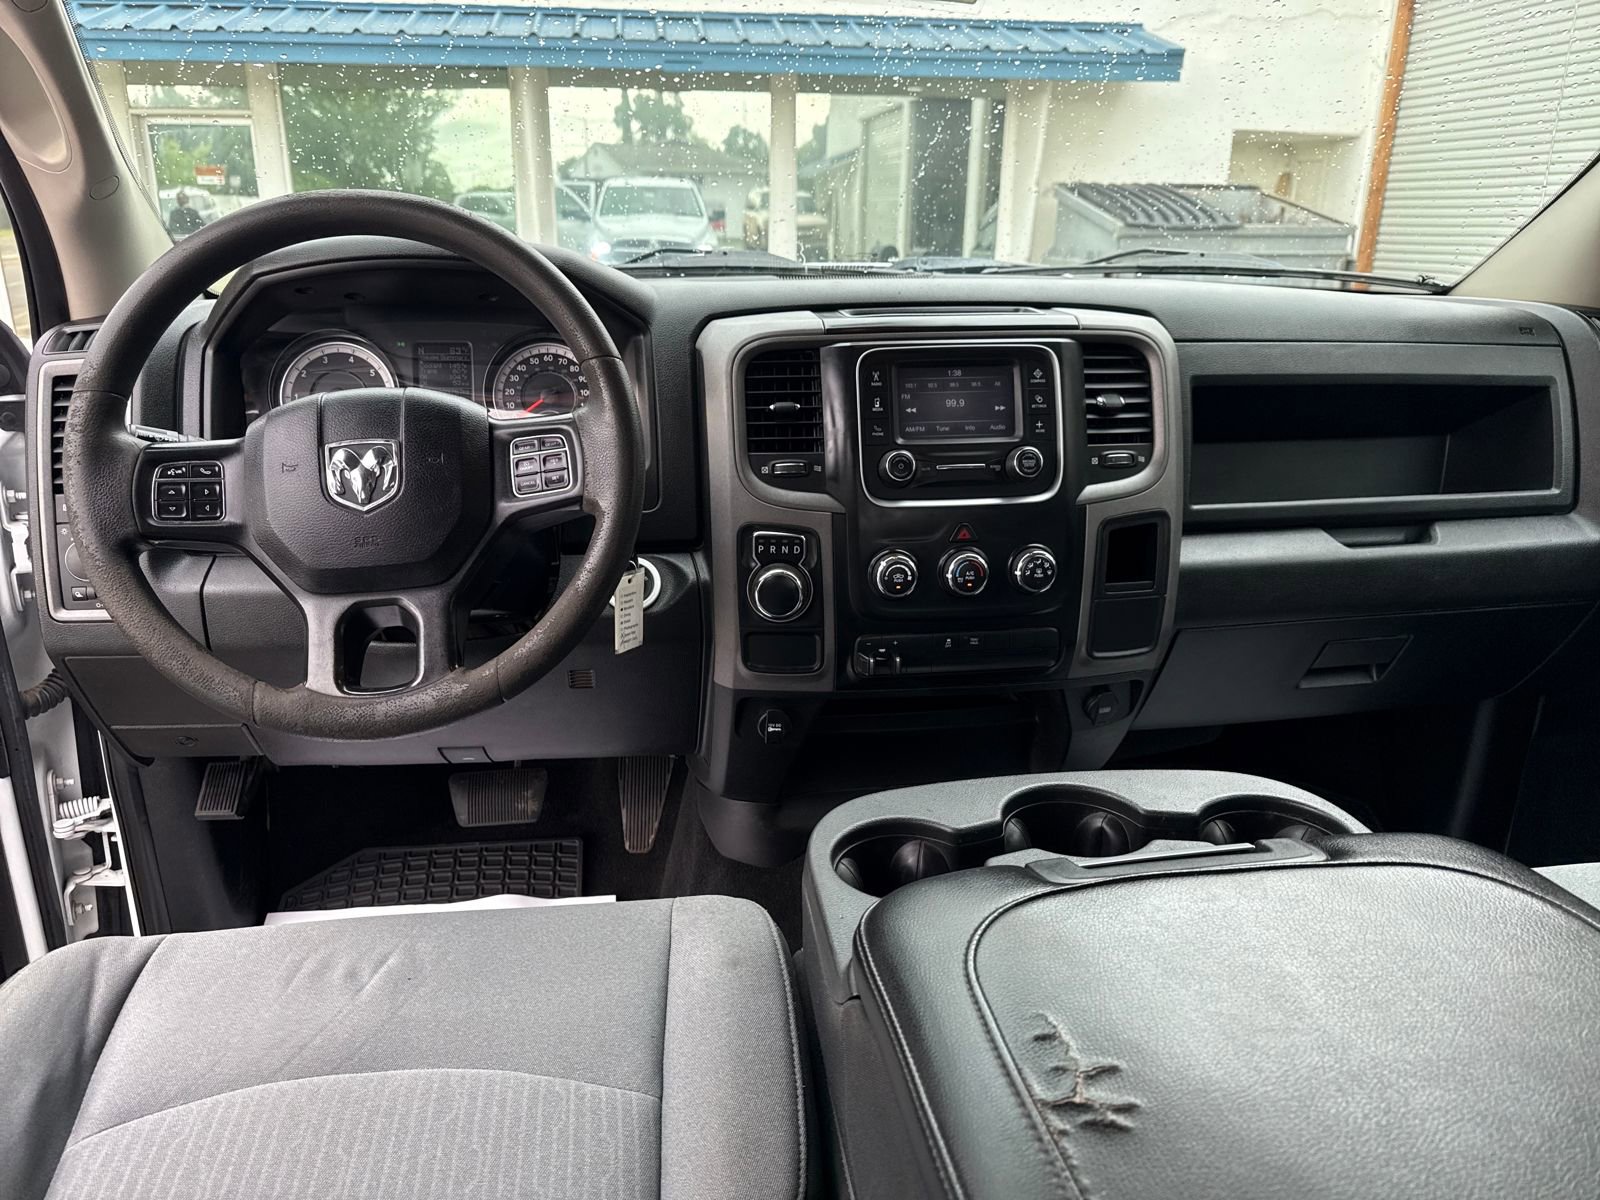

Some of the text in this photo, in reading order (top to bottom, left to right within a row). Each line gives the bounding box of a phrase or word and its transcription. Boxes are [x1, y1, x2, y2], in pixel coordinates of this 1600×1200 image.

[322, 356, 328, 364] 3
[348, 356, 354, 364] 4
[301, 369, 307, 378] 2
[369, 369, 376, 377] 5
[947, 369, 962, 377] 1:38
[945, 398, 965, 408] 99.9
[758, 545, 800, 554] P R N D
